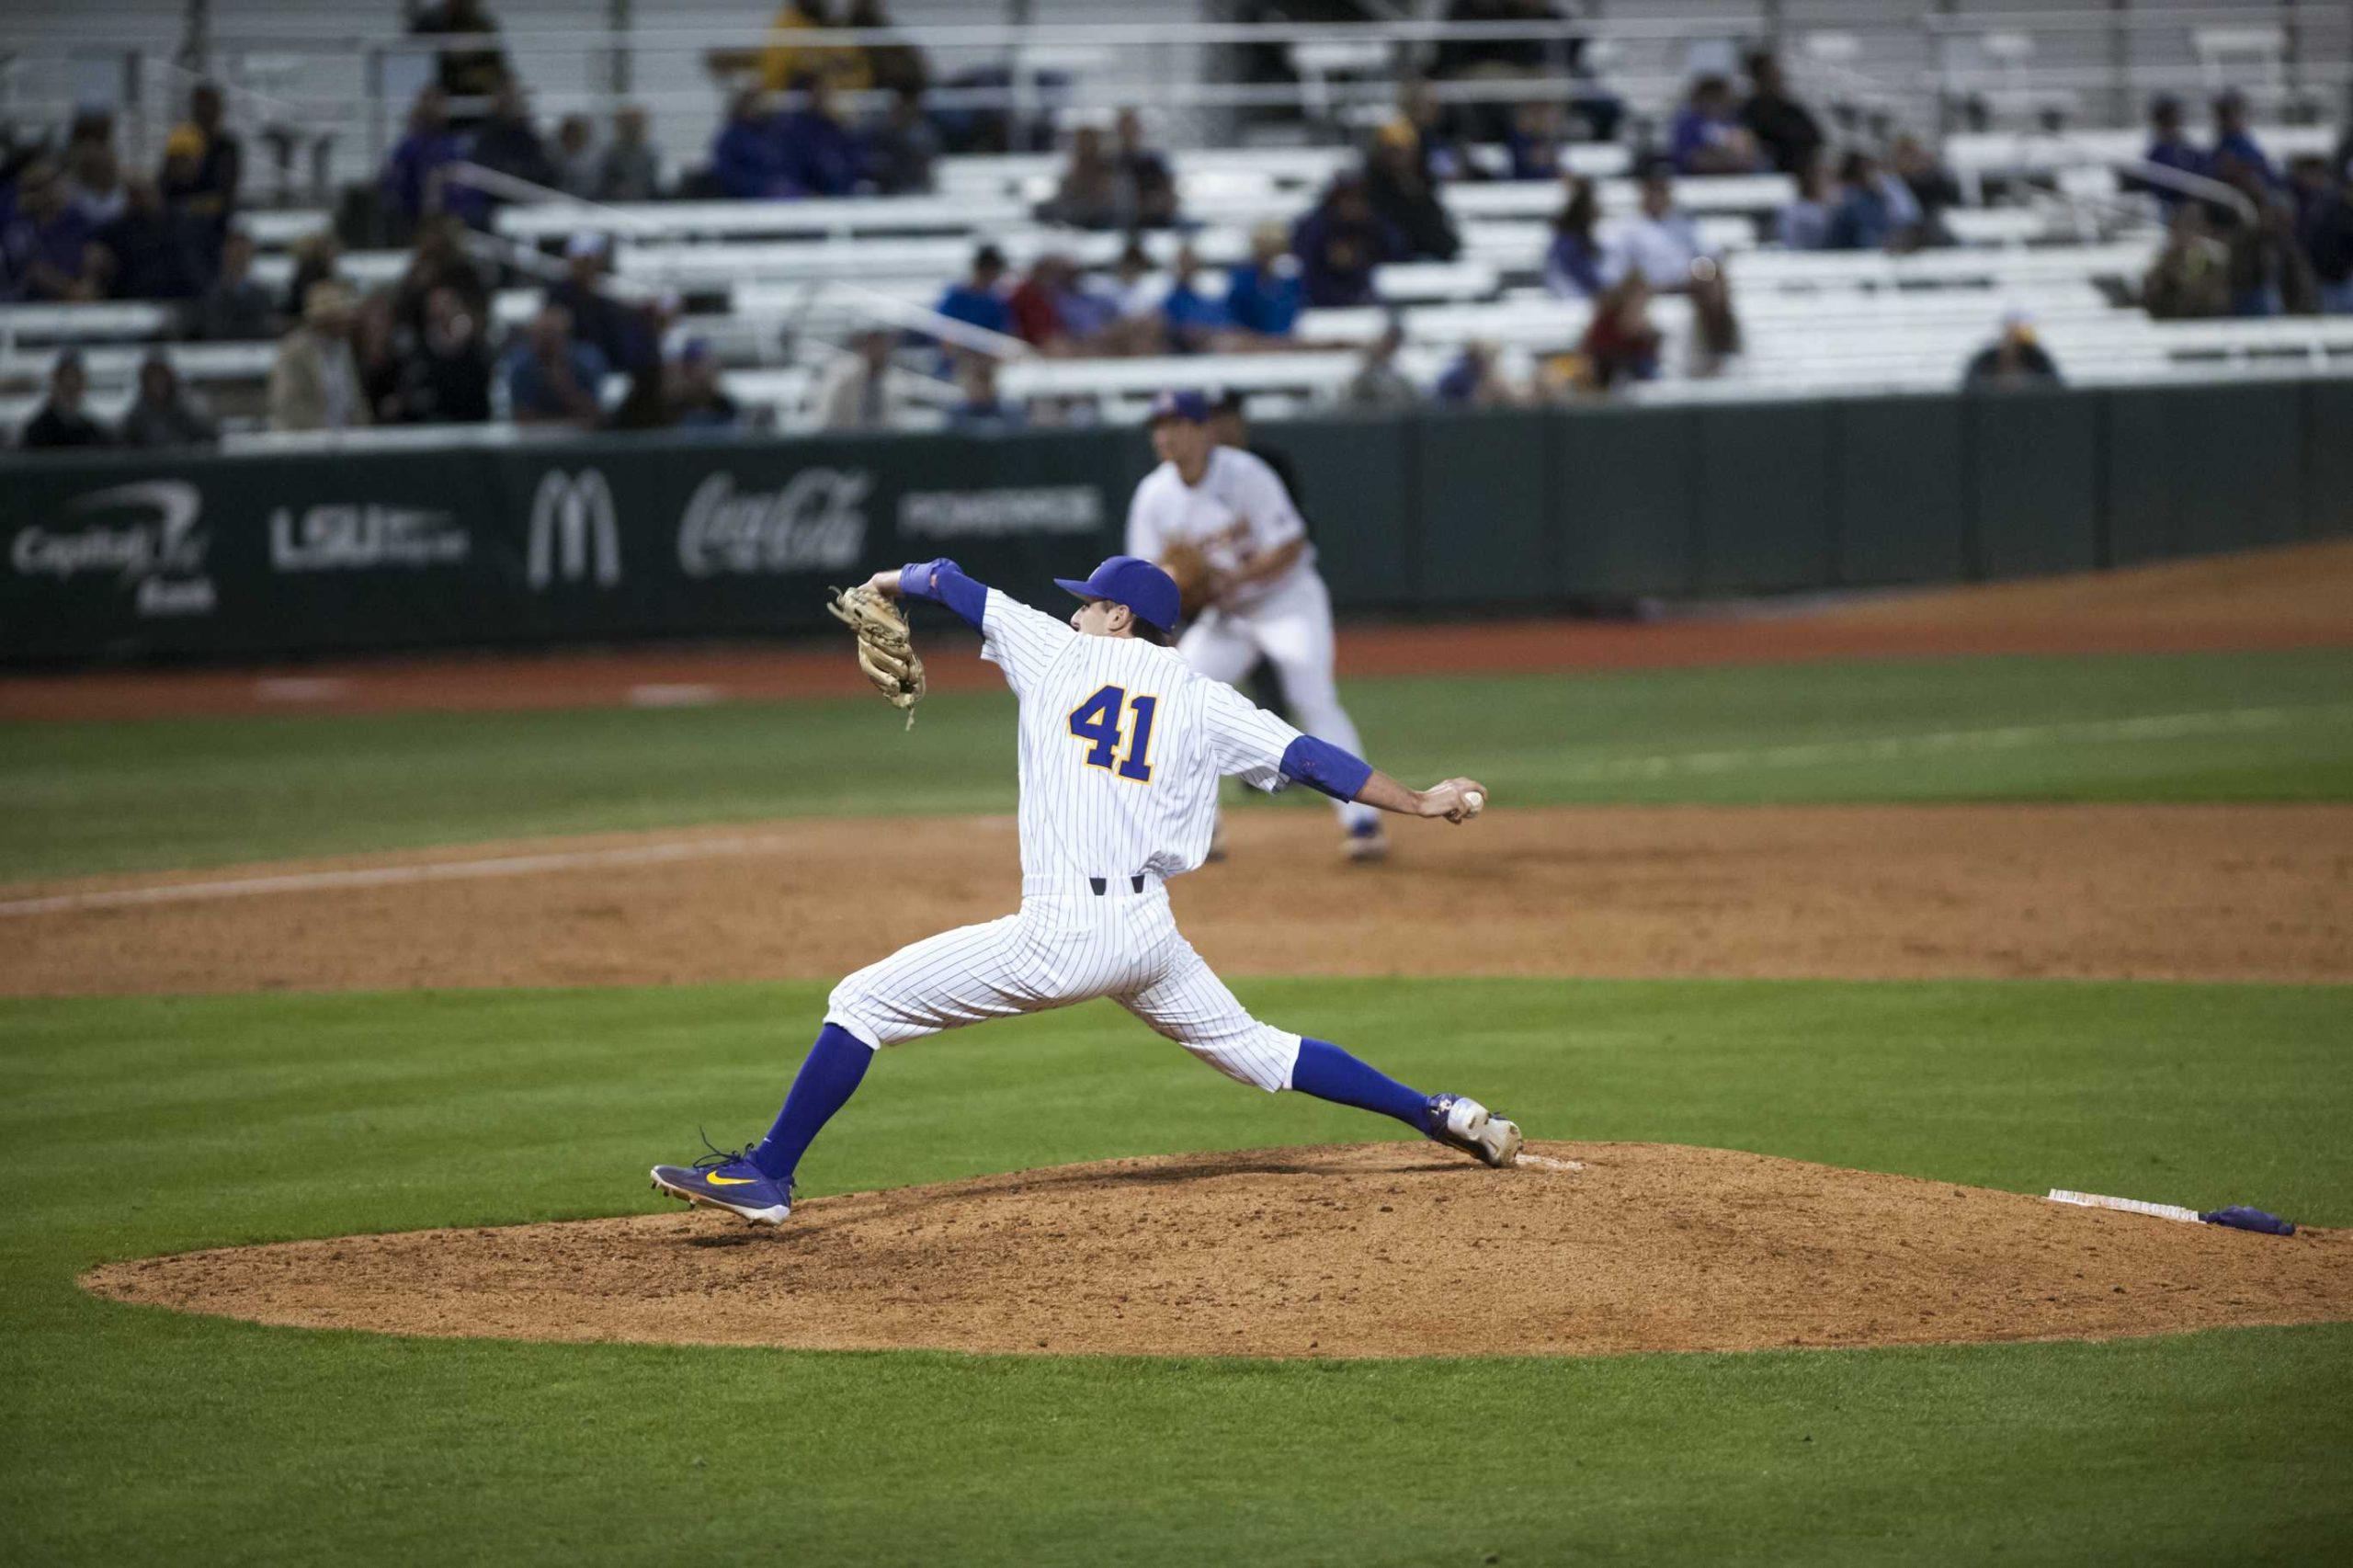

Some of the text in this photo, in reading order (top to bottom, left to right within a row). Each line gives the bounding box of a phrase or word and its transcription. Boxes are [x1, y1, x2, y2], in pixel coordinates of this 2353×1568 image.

[271, 506, 381, 571] LSU
[677, 467, 871, 579] CocaCola
[1068, 684, 1159, 786] 41
